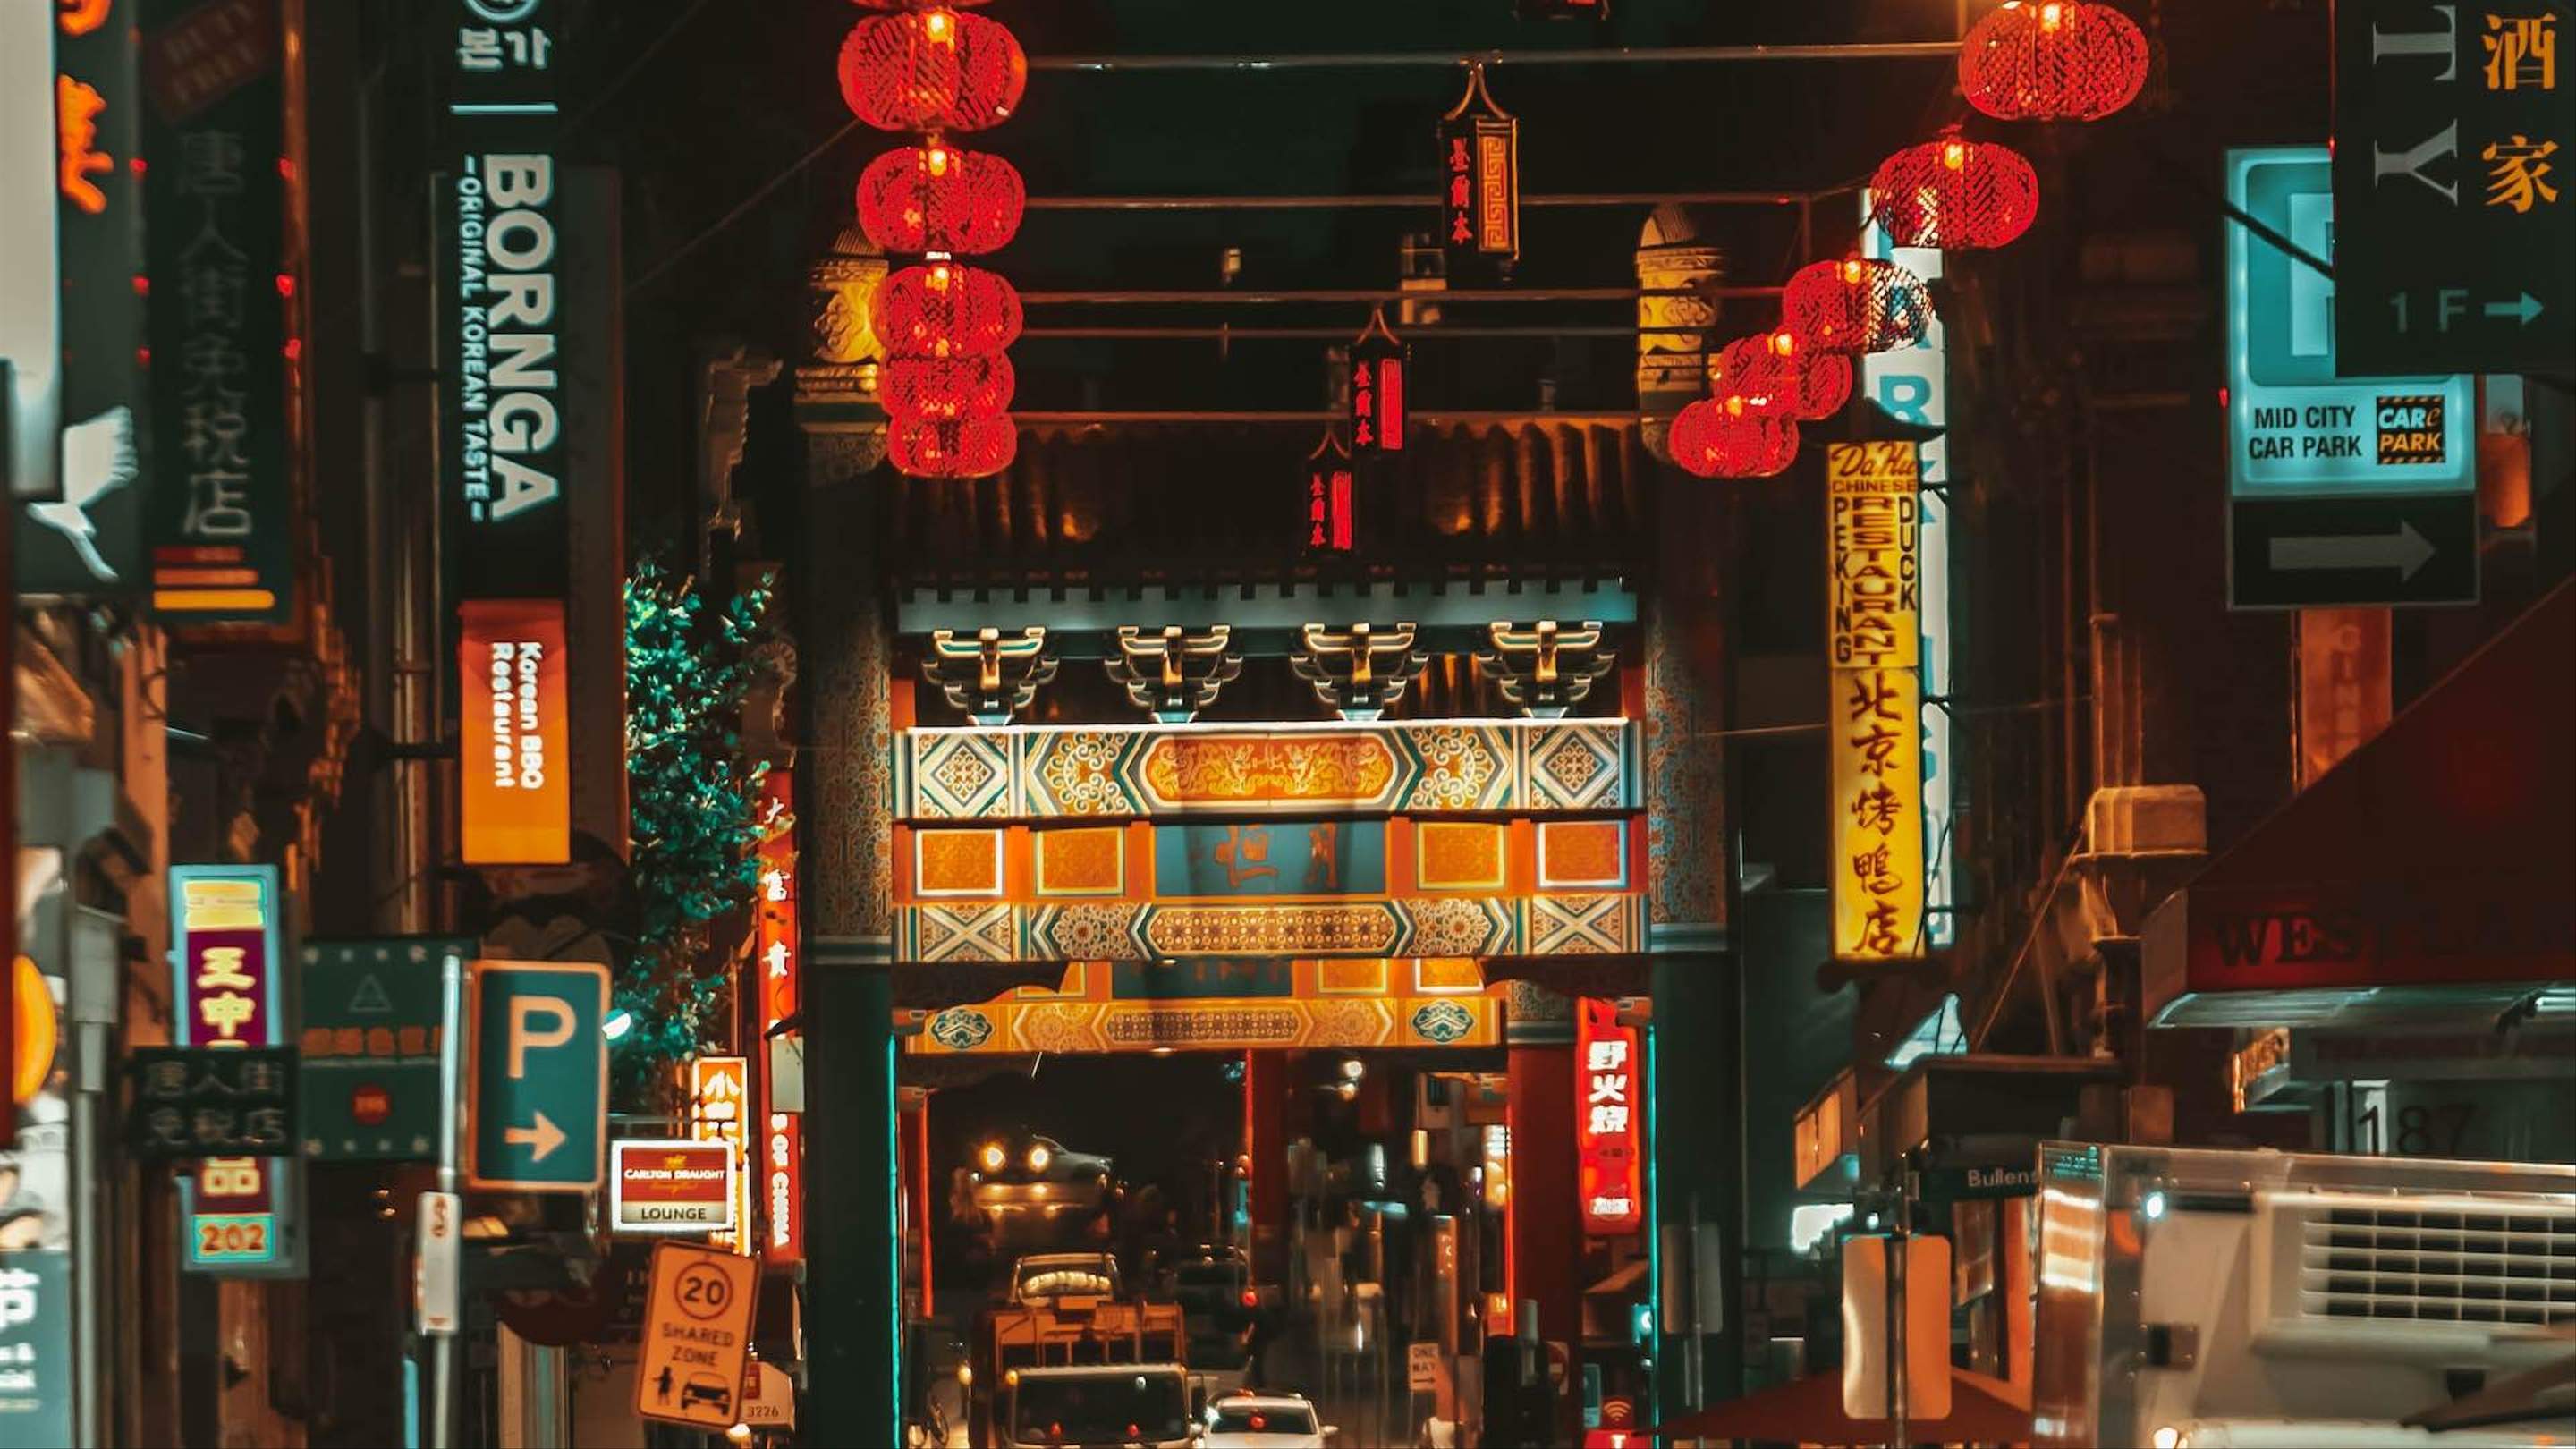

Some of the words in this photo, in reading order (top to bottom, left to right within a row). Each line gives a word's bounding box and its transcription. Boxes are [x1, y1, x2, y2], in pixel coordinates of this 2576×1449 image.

[457, 27, 552, 70] 본가
[2482, 13, 2559, 214] 酒家
[484, 154, 560, 521] BORNGA
[462, 305, 488, 411] KOREAN
[2255, 407, 2297, 429] MID
[2305, 406, 2355, 428] CITY
[2250, 436, 2294, 460] CAR
[2302, 436, 2361, 457] PARK
[2380, 432, 2441, 453] PARK
[1833, 479, 1916, 493] CHINESE
[1834, 496, 1852, 664] PEKING
[1899, 496, 1916, 611] DUCK
[1852, 496, 1895, 665] RESTAURANT
[518, 641, 543, 730] Korean
[491, 642, 515, 787] Restaurant
[508, 996, 576, 1079] P
[2359, 1102, 2477, 1157] 187
[624, 1169, 672, 1179] CARLTON
[674, 1169, 724, 1179] DRAUGHT
[641, 1208, 707, 1220] LOUNGE
[199, 1225, 265, 1251] 202
[685, 1276, 725, 1305] 20
[663, 1322, 733, 1347] SHARED
[672, 1346, 718, 1366] ZONE
